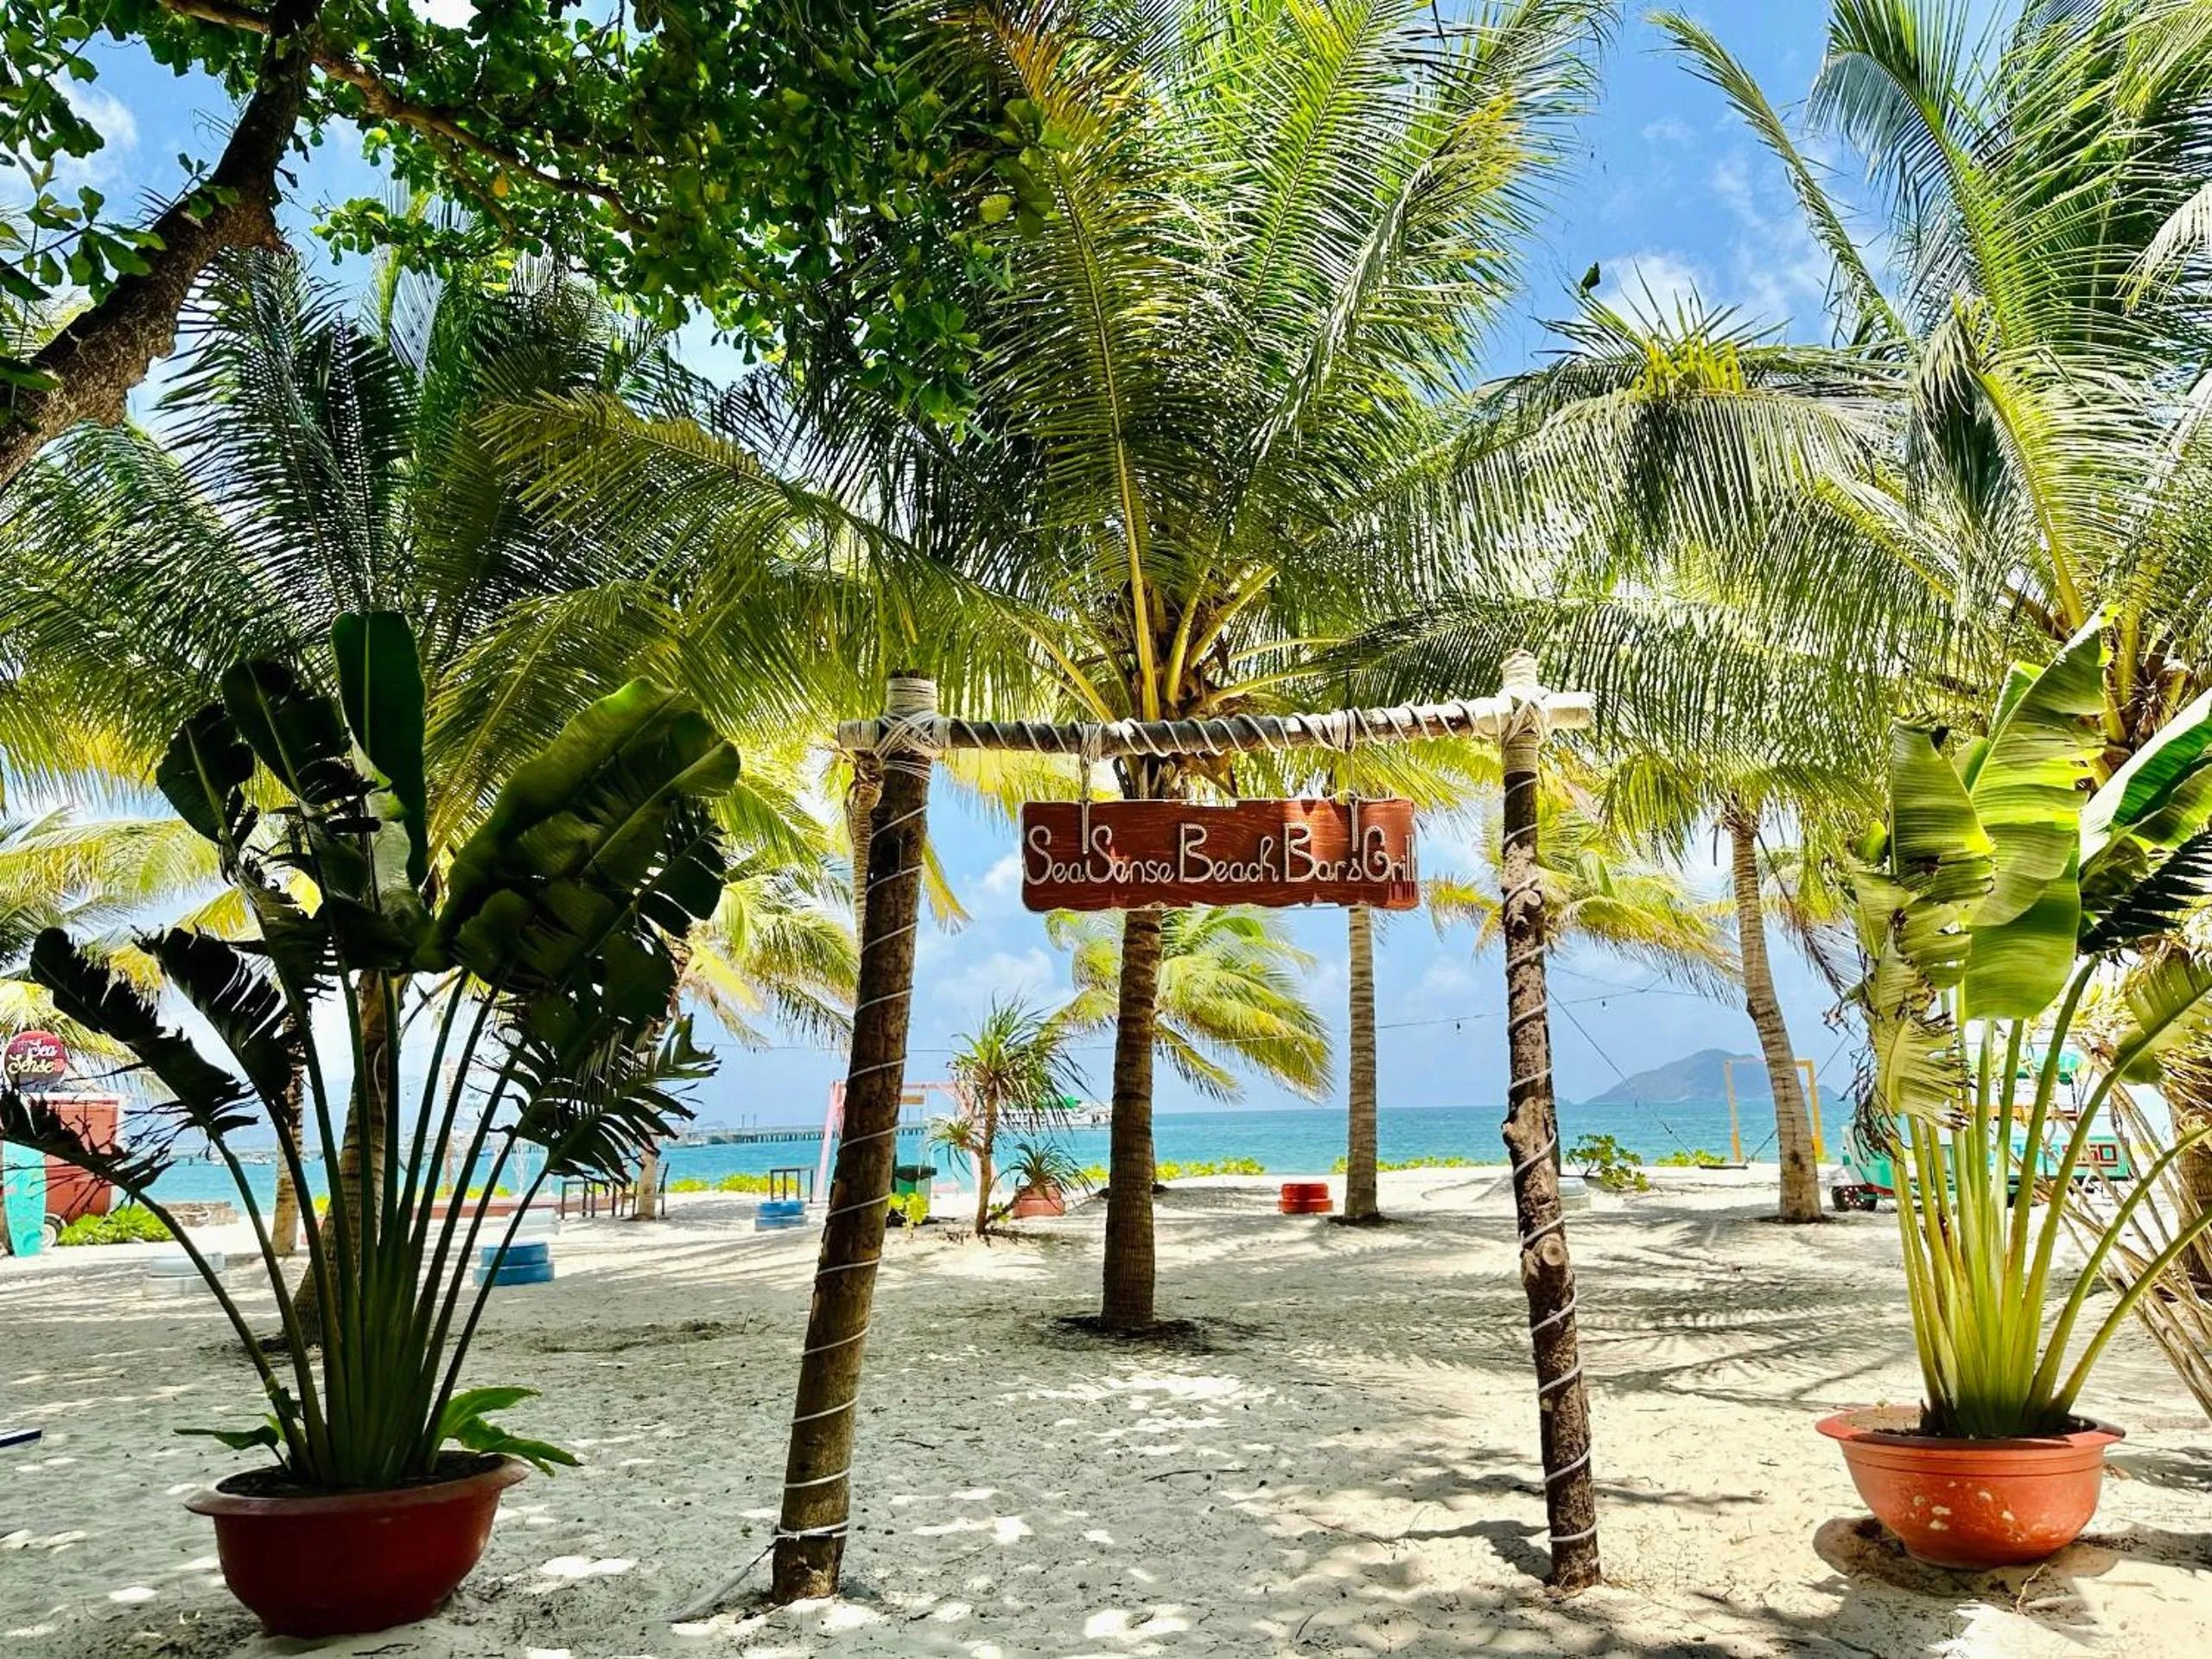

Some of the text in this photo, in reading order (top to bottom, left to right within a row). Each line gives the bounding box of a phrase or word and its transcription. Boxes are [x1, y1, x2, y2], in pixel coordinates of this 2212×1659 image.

[1023, 824, 1085, 885] Sea
[1085, 824, 1175, 884] Sense
[1179, 823, 1280, 883] Beach
[1363, 825, 1416, 882] Grill
[28, 1039, 58, 1057] Sea
[7, 1053, 55, 1074] Sense
